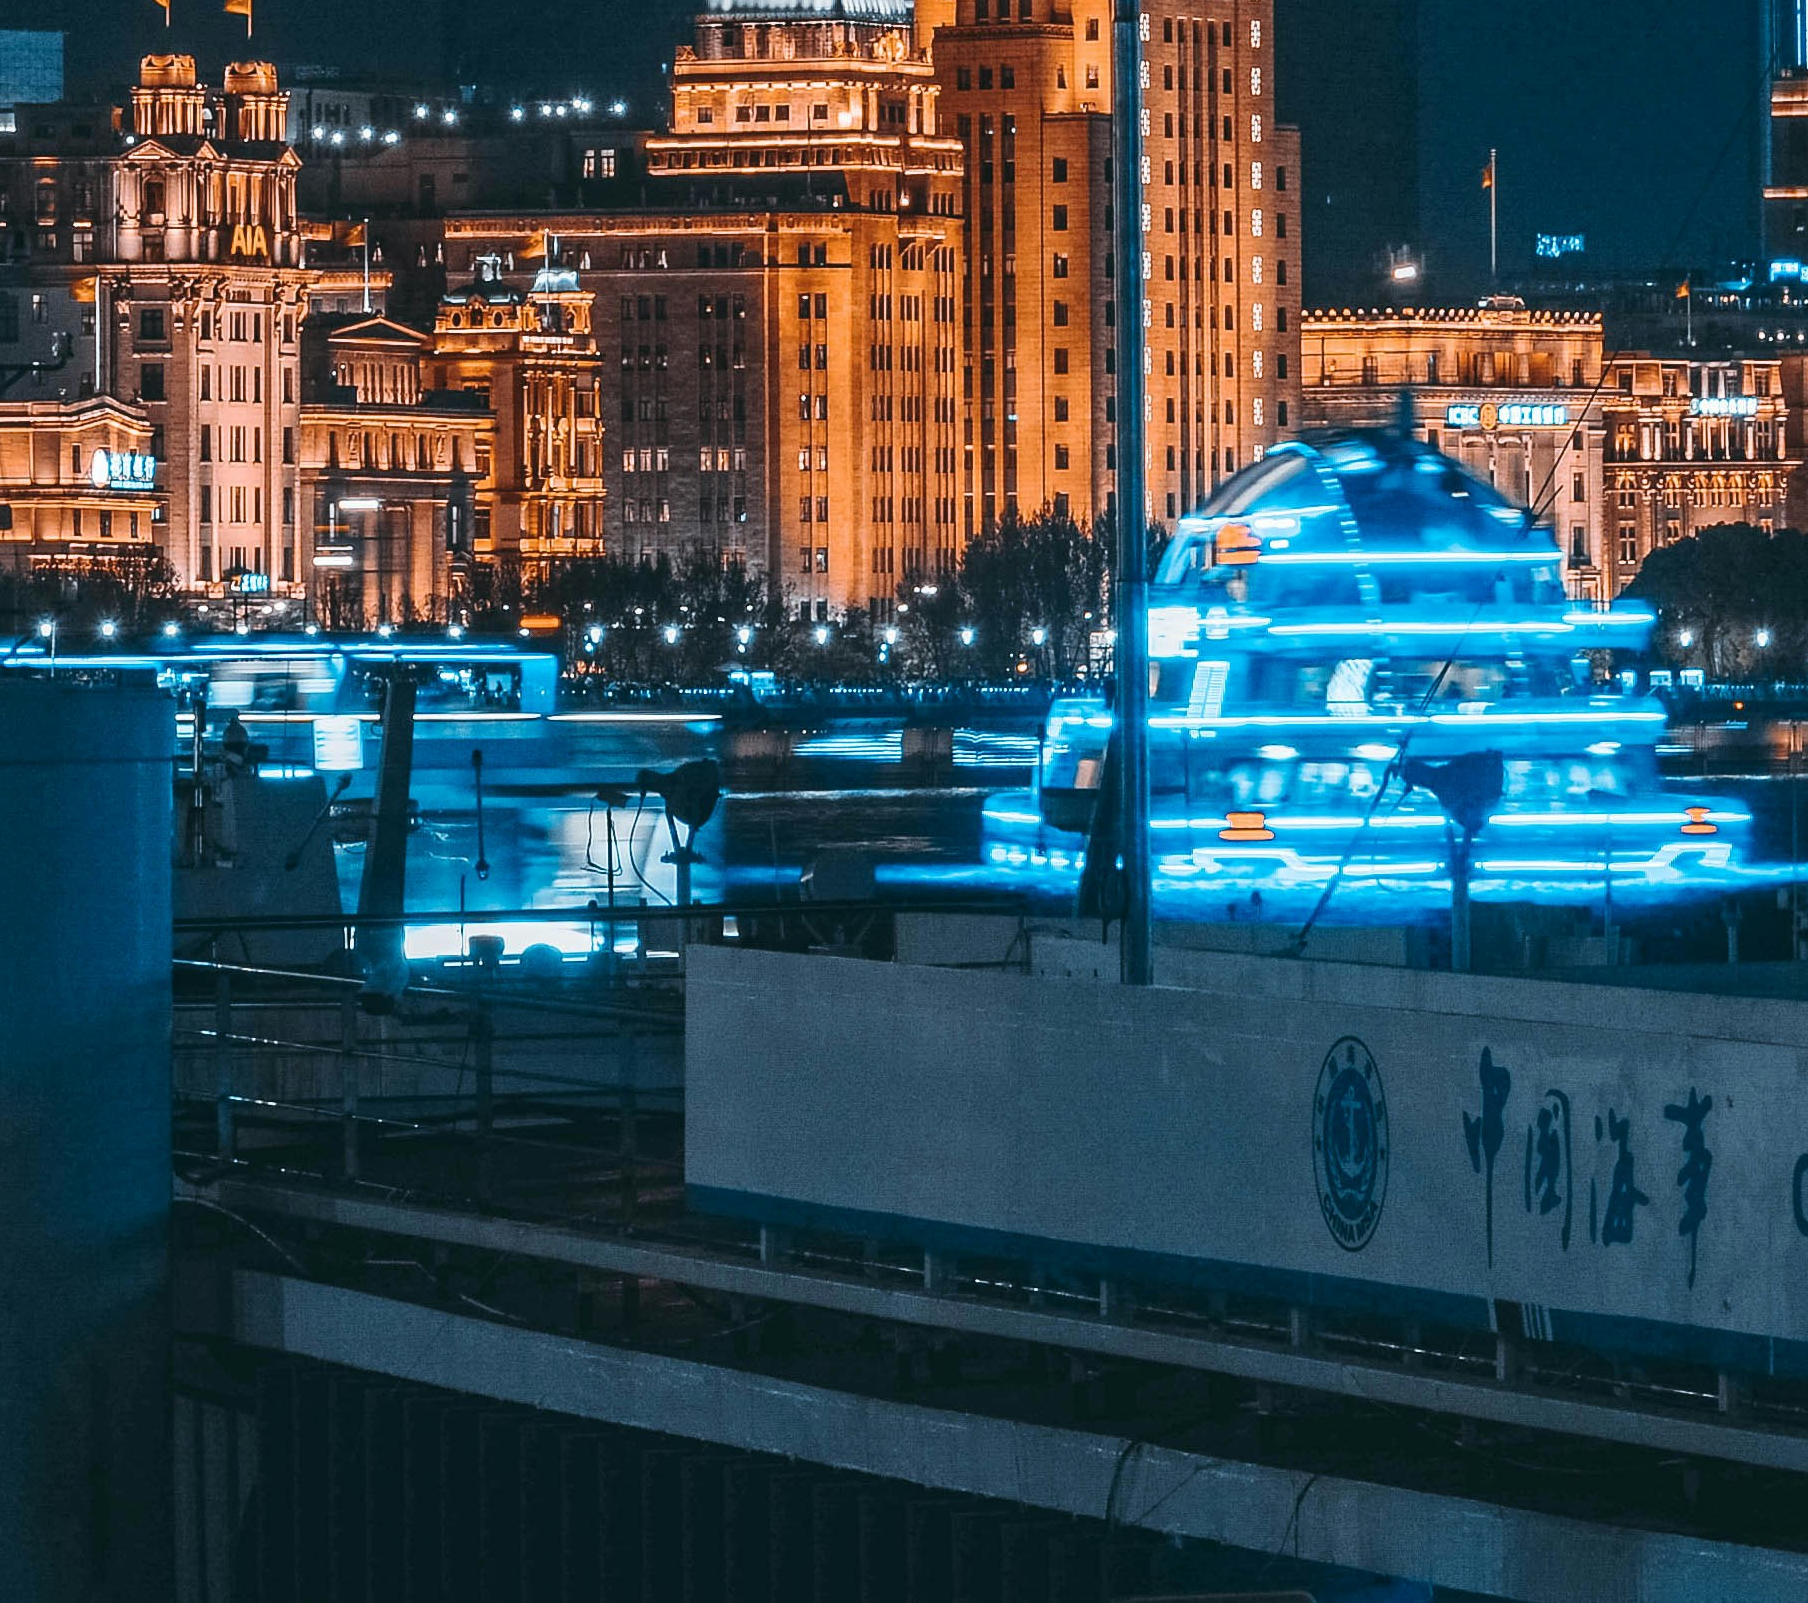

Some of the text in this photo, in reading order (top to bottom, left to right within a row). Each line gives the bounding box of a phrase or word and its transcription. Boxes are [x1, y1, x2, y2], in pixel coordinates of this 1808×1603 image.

[230, 224, 268, 257] AIA
[1462, 1046, 1714, 1292] 中国海事
